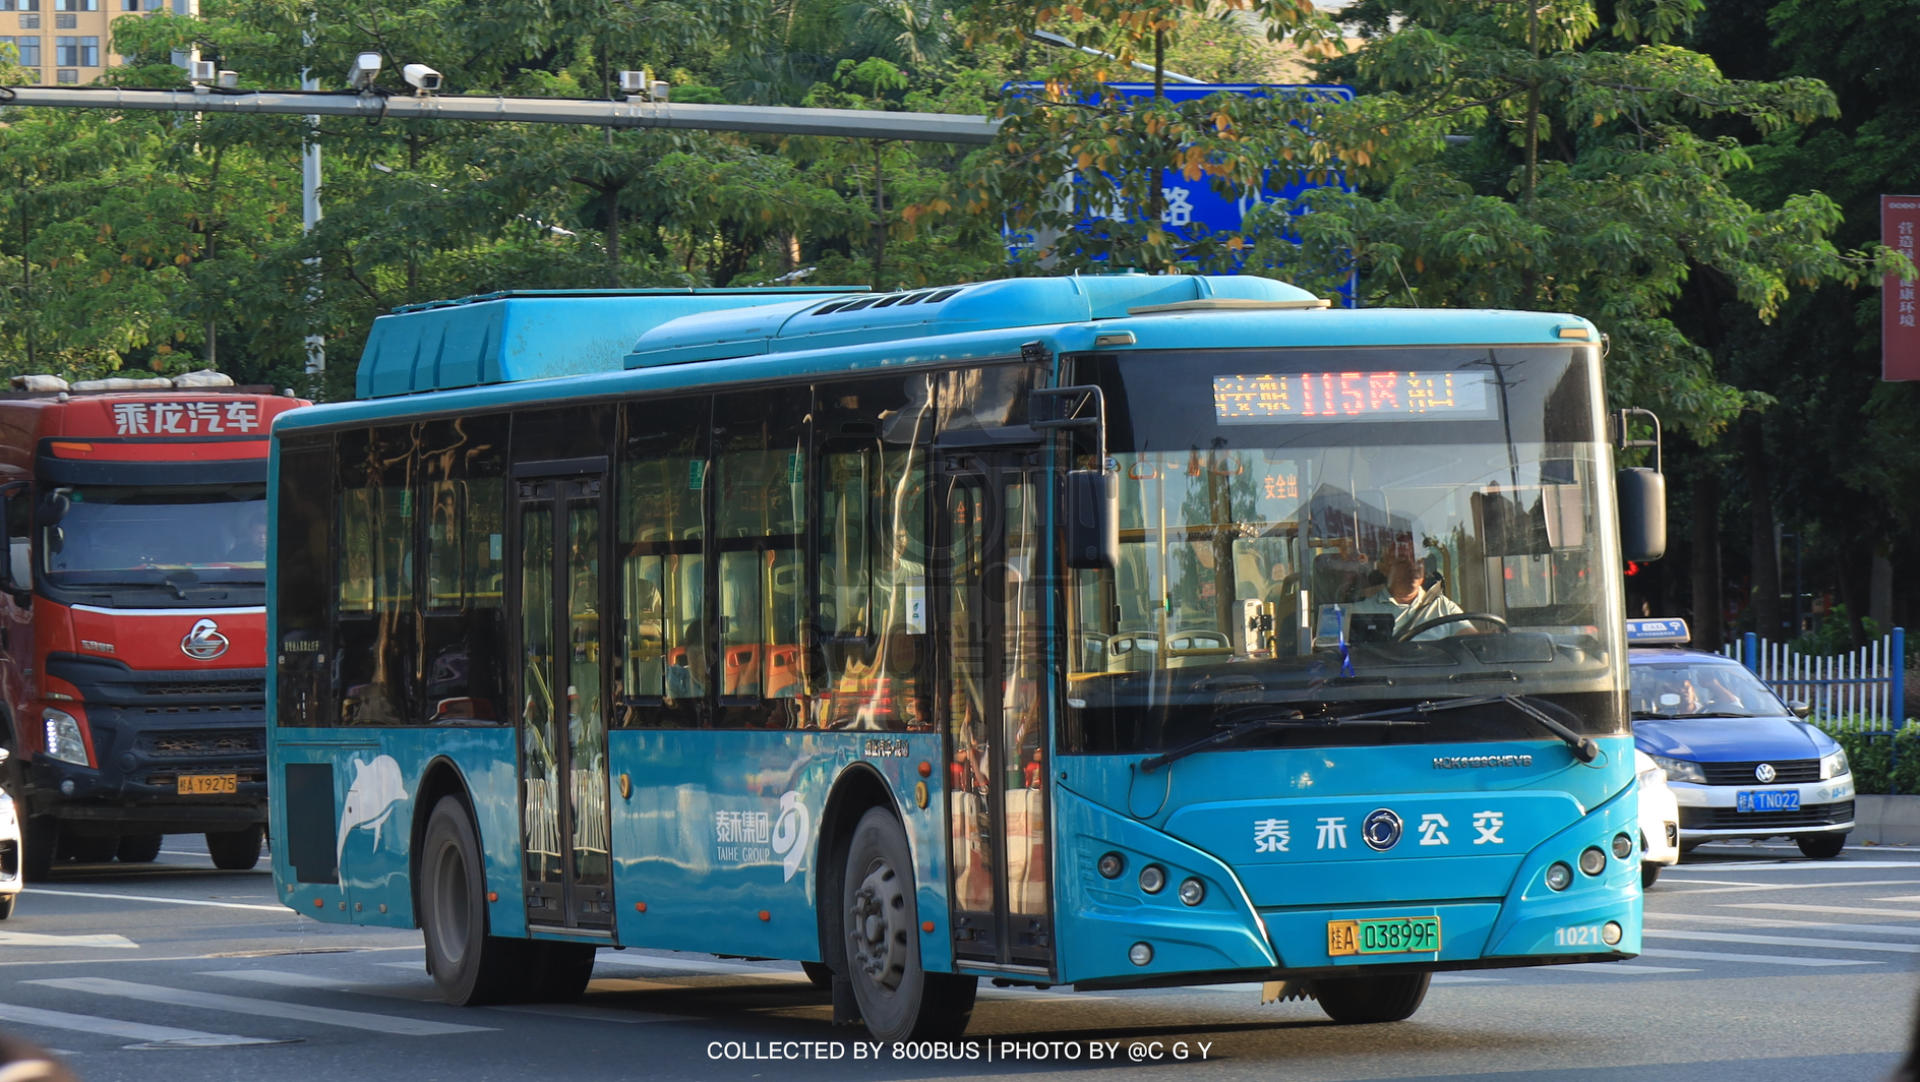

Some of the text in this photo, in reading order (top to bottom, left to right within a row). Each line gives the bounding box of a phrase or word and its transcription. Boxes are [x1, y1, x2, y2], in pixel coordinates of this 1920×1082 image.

[113, 402, 259, 435] 乘龙汽车
[1264, 474, 1298, 499] 安全出
[716, 811, 769, 843] 泰禾集团
[717, 846, 770, 862] TAIHE GROUP
[1556, 926, 1598, 946] 1021
